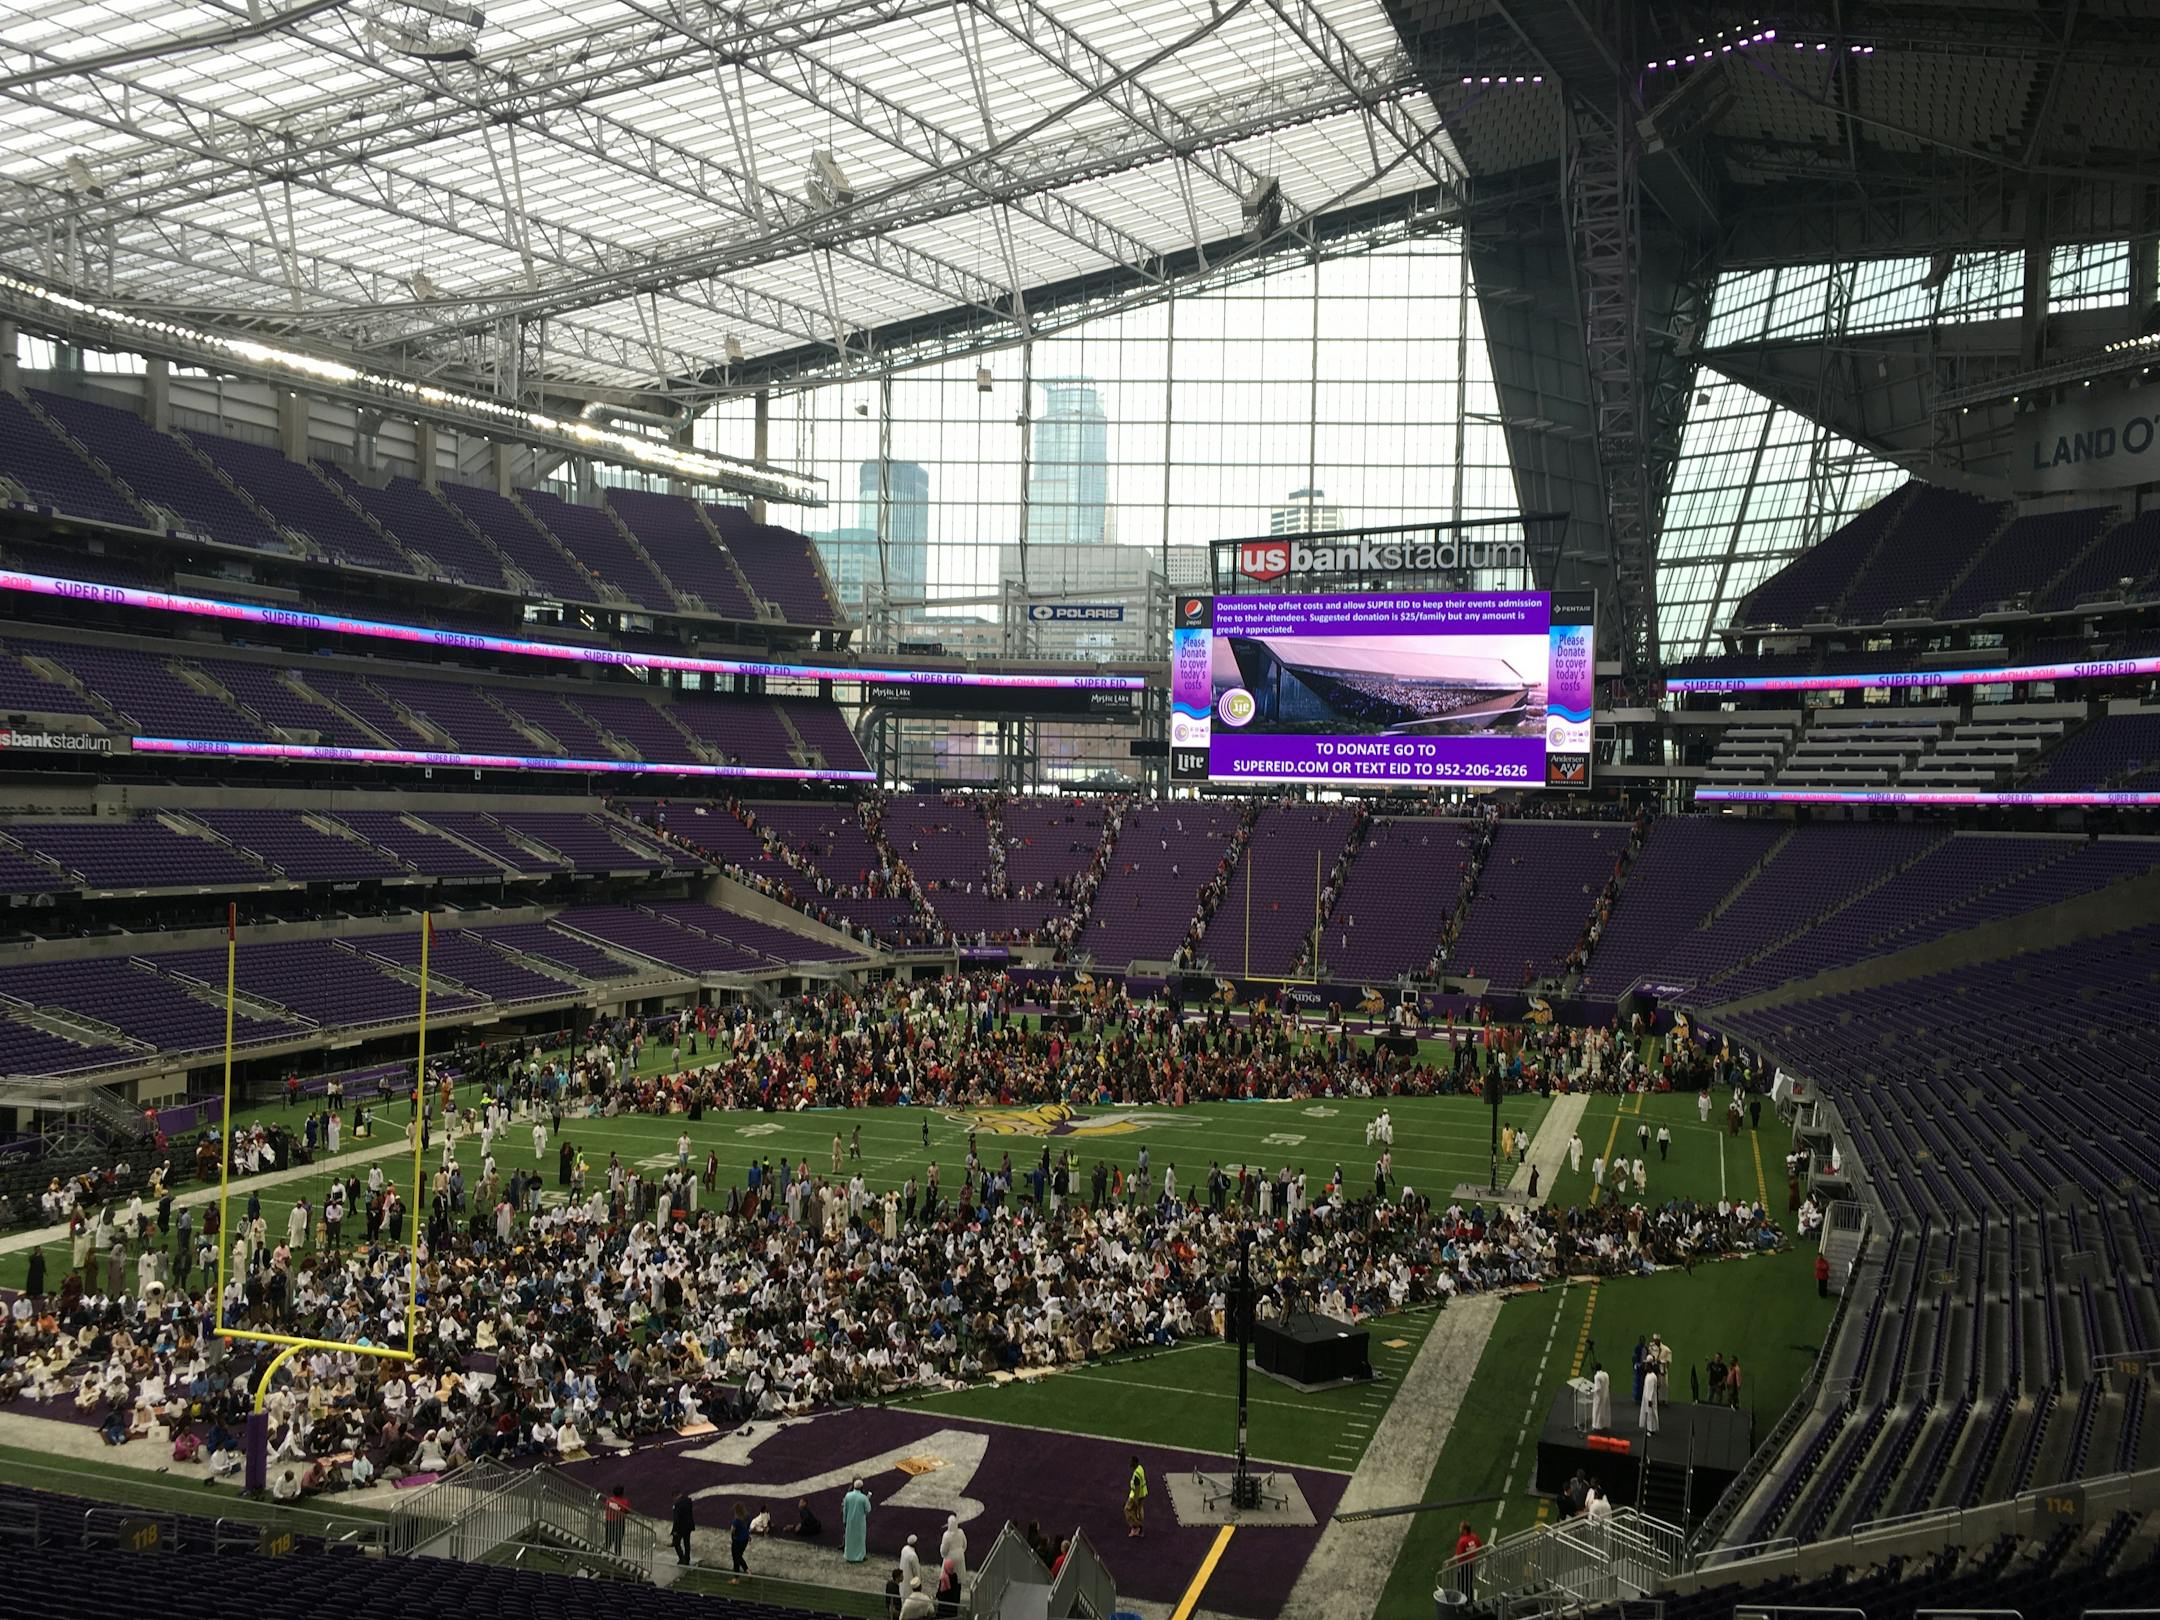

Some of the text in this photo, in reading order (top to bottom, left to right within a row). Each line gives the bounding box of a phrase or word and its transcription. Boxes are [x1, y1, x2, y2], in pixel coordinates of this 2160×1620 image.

[2033, 427, 2116, 470] LAND
[55, 581, 125, 603] SUPER EID
[146, 595, 164, 609] EID
[219, 605, 244, 617] 2018
[1217, 599, 1543, 613] Donations help offset costs and allow SUPER EID to keep their events admission
[261, 610, 321, 629] SUPER EID
[1056, 608, 1119, 619] POLARIS
[1216, 611, 1525, 624] free to their attendees. Suggested donation is $25/family but any amount is
[1216, 625, 1295, 635] greatly appreciated.
[434, 632, 485, 649] SUPER EID
[1183, 636, 1206, 648] Please
[1559, 634, 1585, 646] Please
[583, 650, 633, 665] SUPER EID
[1181, 647, 1207, 658] Donate
[1557, 646, 1586, 657] Donate
[1180, 658, 1207, 670] to cover
[1555, 658, 1587, 670] to cover
[2074, 661, 2137, 678] SUPER EID
[739, 664, 791, 677] SUPER EID
[1181, 669, 1206, 682] today's
[1556, 669, 1585, 682] today's
[2033, 668, 2056, 680] 2018
[910, 673, 963, 685] SUPER EID
[1074, 678, 1127, 689] SUPER EID
[1184, 679, 1202, 690] costs
[1878, 674, 1942, 687] SUPER EID
[1560, 680, 1581, 691] costs
[1683, 680, 1746, 691] SUPER EID
[186, 741, 214, 752] SUPER
[216, 742, 230, 753] EID
[314, 747, 338, 758] SUPER
[340, 748, 352, 759] EID
[1316, 742, 1436, 757] TO DONATE GO TO
[426, 753, 448, 763] SUPER
[450, 755, 461, 764] EID
[526, 758, 546, 768] SUPER
[1177, 753, 1205, 772] Lite
[1550, 754, 1585, 763] Andersen
[714, 767, 734, 776] SUPER
[735, 768, 747, 777] EID
[815, 770, 835, 779] SUPER
[1233, 760, 1528, 777] SUPEREID.COM OR TEXT EID TO 952-206-2626
[1727, 791, 1769, 800] SUPER EID
[1866, 793, 1906, 801] SUPER EID
[1997, 794, 2033, 802] SUPER EID
[2107, 794, 2128, 802] SUPER
[2047, 1498, 2076, 1515] 114
[132, 1524, 158, 1550] 118
[270, 1533, 291, 1558] 118
